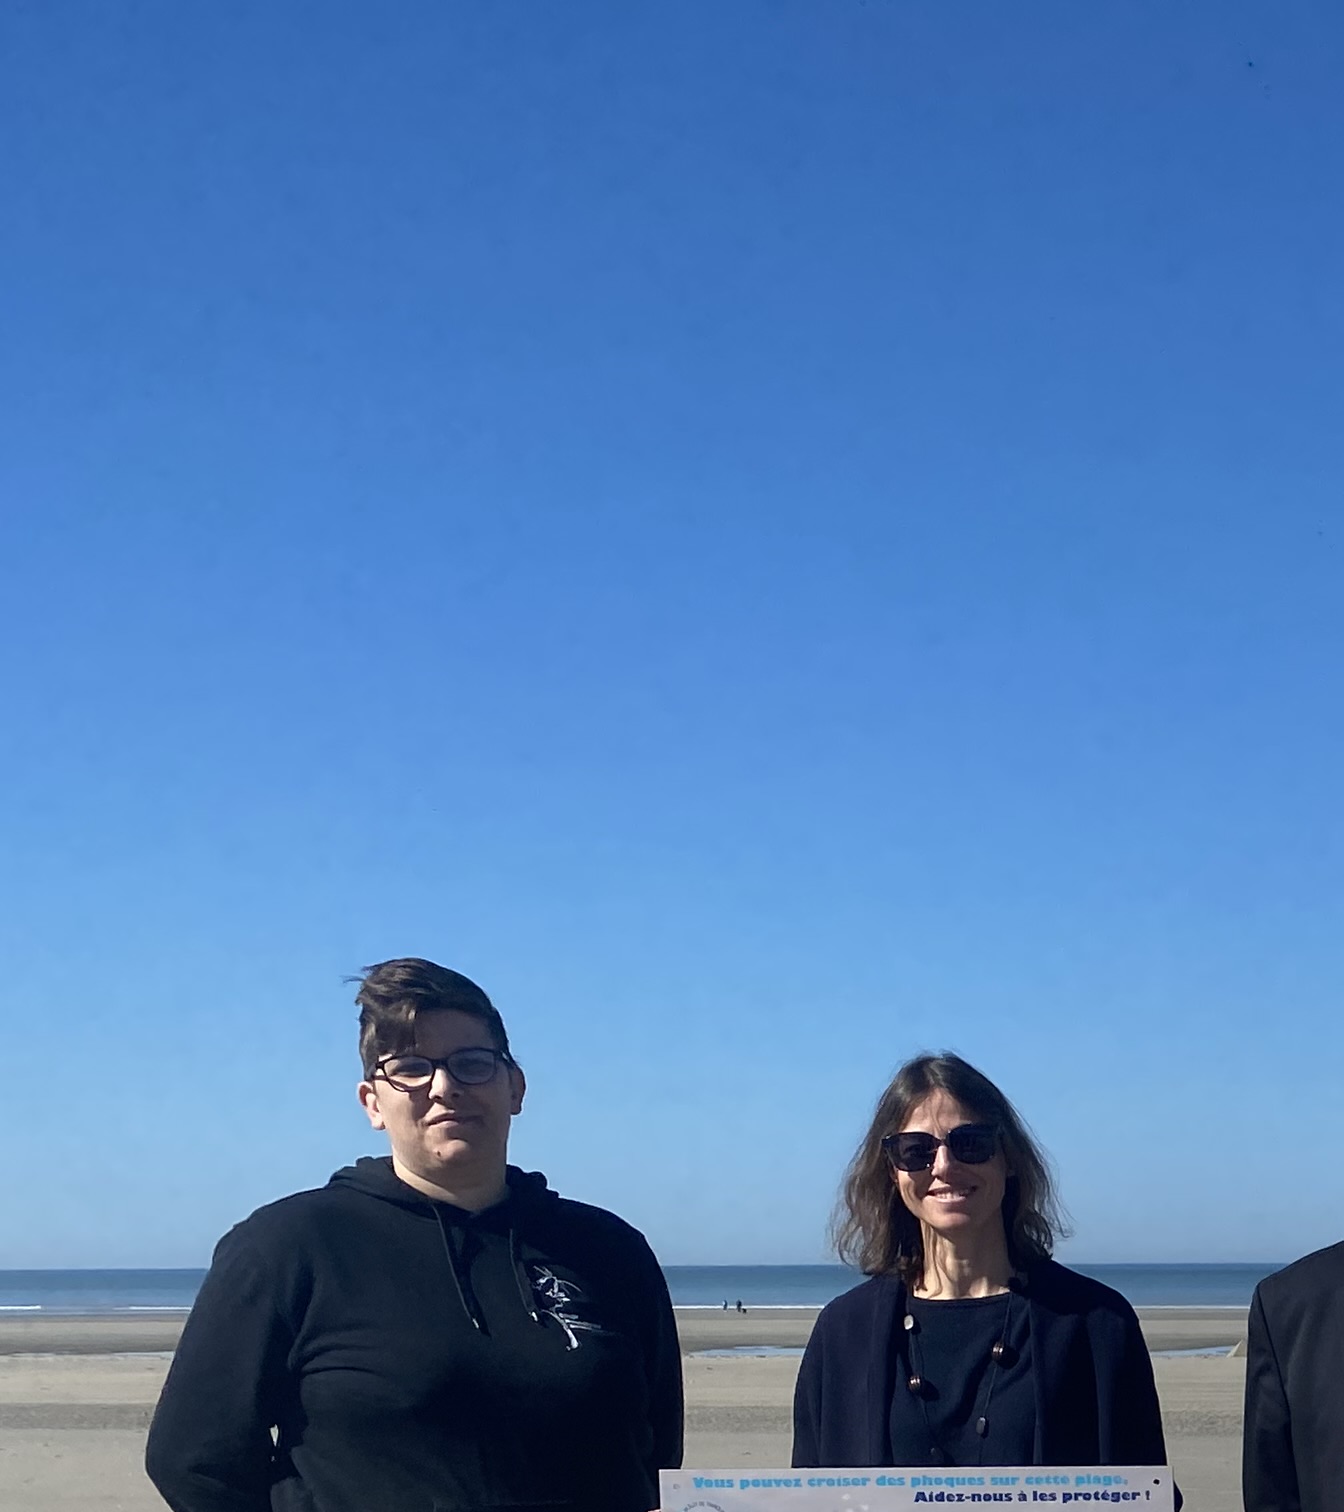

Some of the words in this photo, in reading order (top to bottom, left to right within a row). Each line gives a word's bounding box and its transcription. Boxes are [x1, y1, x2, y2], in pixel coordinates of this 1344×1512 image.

[693, 1477, 734, 1489] Vous
[740, 1477, 802, 1490] pouvez
[807, 1476, 870, 1487] croiser
[876, 1475, 905, 1486] des
[911, 1475, 985, 1488] phoques
[990, 1476, 1020, 1486] sur
[1025, 1475, 1070, 1486] cette
[914, 1491, 1013, 1503] Aidez-nous
[1017, 1490, 1028, 1502] à
[1032, 1490, 1057, 1502] les
[1062, 1489, 1141, 1503] protéger
